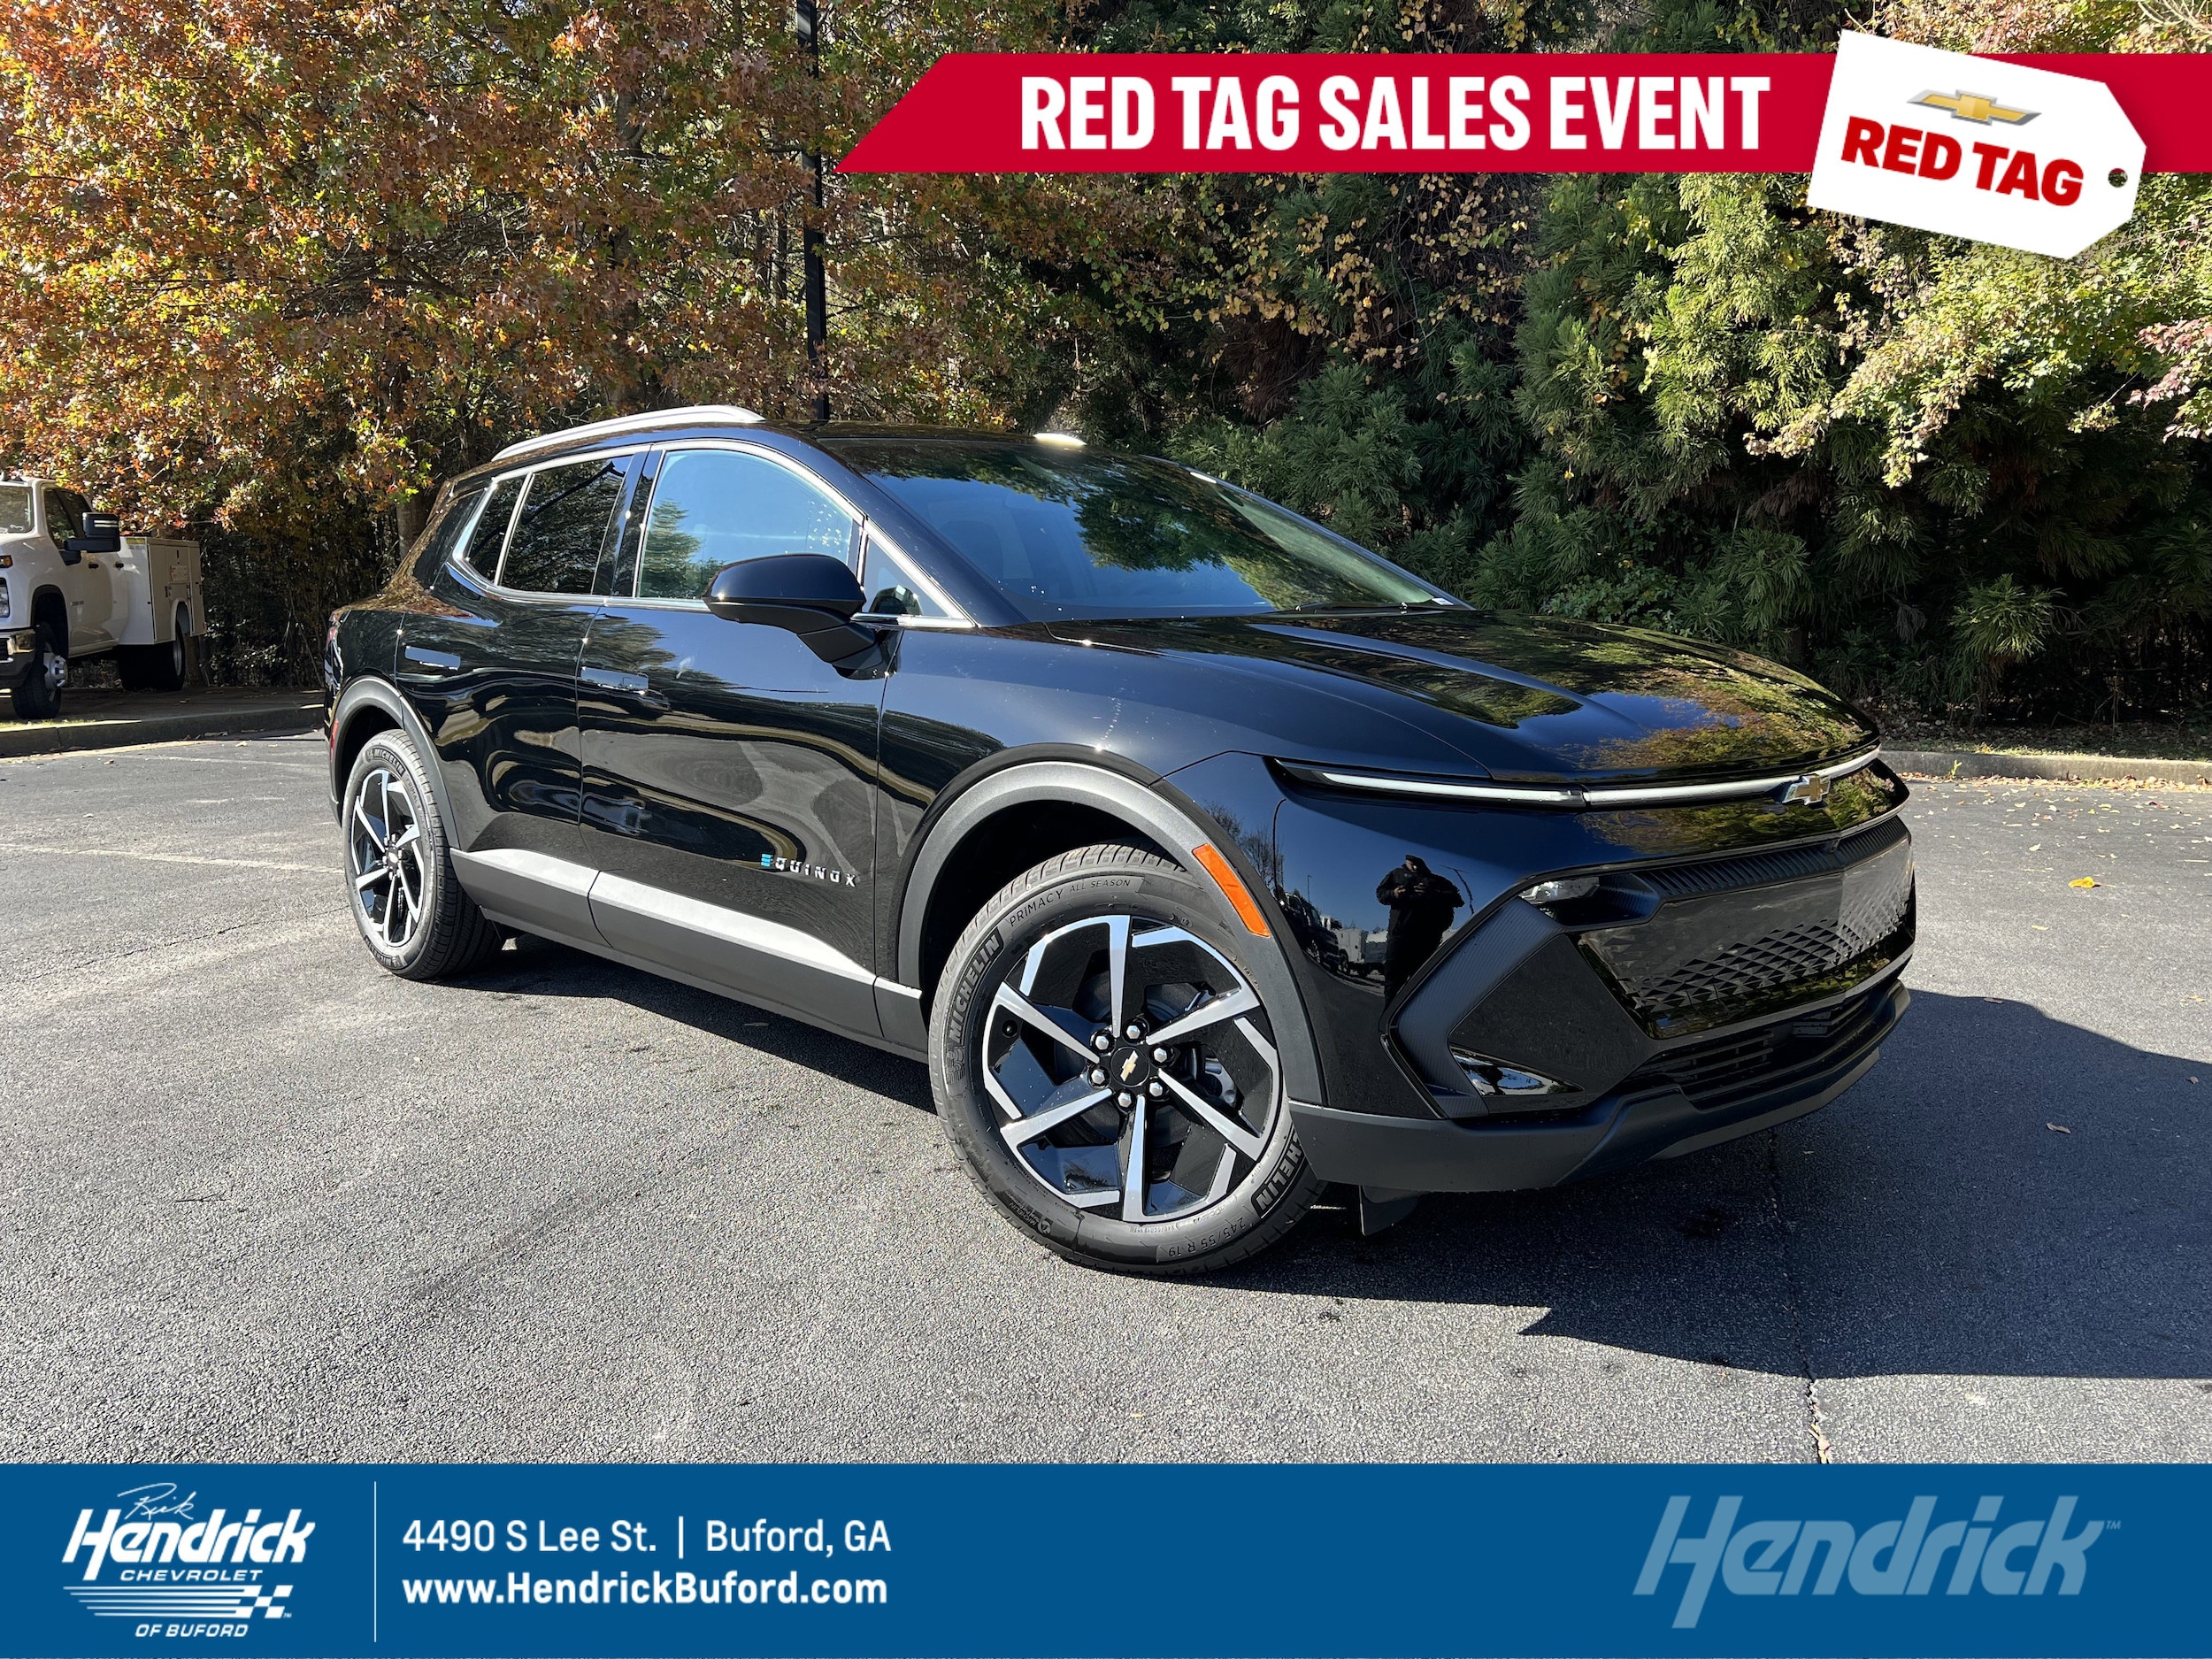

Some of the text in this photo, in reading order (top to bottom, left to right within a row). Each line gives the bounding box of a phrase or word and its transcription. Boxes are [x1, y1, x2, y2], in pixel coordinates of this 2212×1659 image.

[373, 749, 404, 776] MICHELIN
[761, 853, 856, 887] EQUINOX
[1009, 879, 1131, 927] PRIMACY ALL SEASON
[949, 933, 1000, 1044] MICHELIN
[1256, 1131, 1302, 1211] HELIN
[1187, 1242, 1196, 1253] R
[1201, 1217, 1247, 1250] 245/55
[1168, 1246, 1182, 1257] 19
